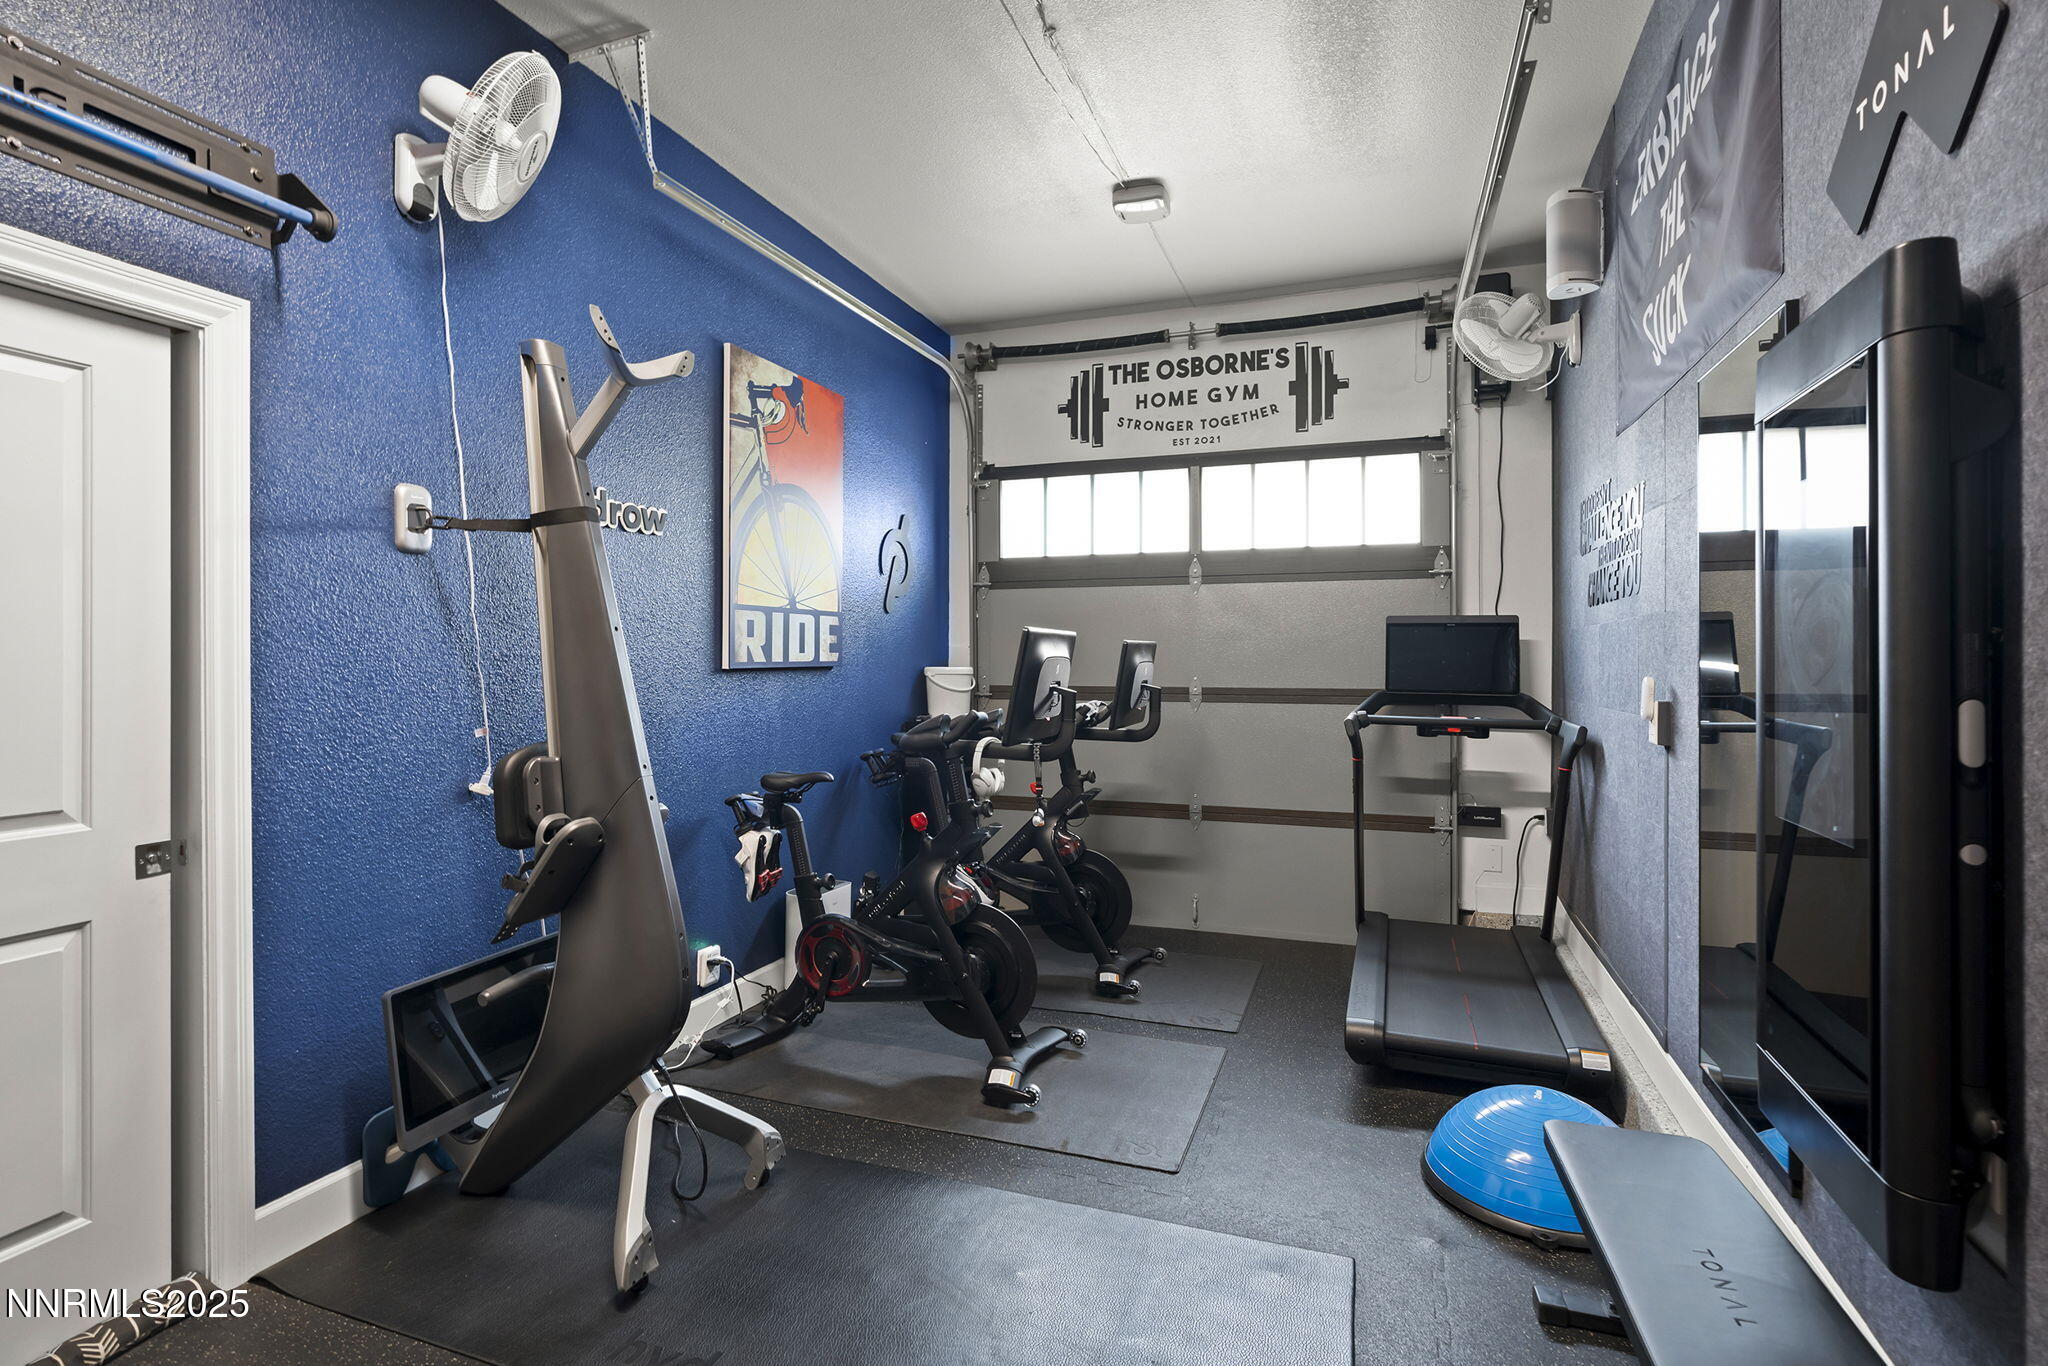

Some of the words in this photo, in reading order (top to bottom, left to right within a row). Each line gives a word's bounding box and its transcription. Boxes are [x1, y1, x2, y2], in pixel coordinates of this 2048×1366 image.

[1856, 5, 1955, 131] TONAL
[1631, 0, 1720, 216] EMBRACE
[1659, 160, 1687, 269] THE
[1642, 253, 1692, 366] SUCK
[1108, 361, 1150, 385] THE
[1156, 347, 1290, 380] OSBORNE'S
[1117, 416, 1194, 431] STRONGER
[1200, 403, 1280, 430] TOGETHER
[1136, 389, 1198, 410] HOME
[1207, 383, 1259, 403] GYM
[1172, 437, 1190, 446] EST
[1194, 435, 1222, 446] 2021
[1621, 553, 1642, 598] YOU
[735, 610, 840, 662] RIDE
[1692, 1248, 1759, 1327] TONAL
